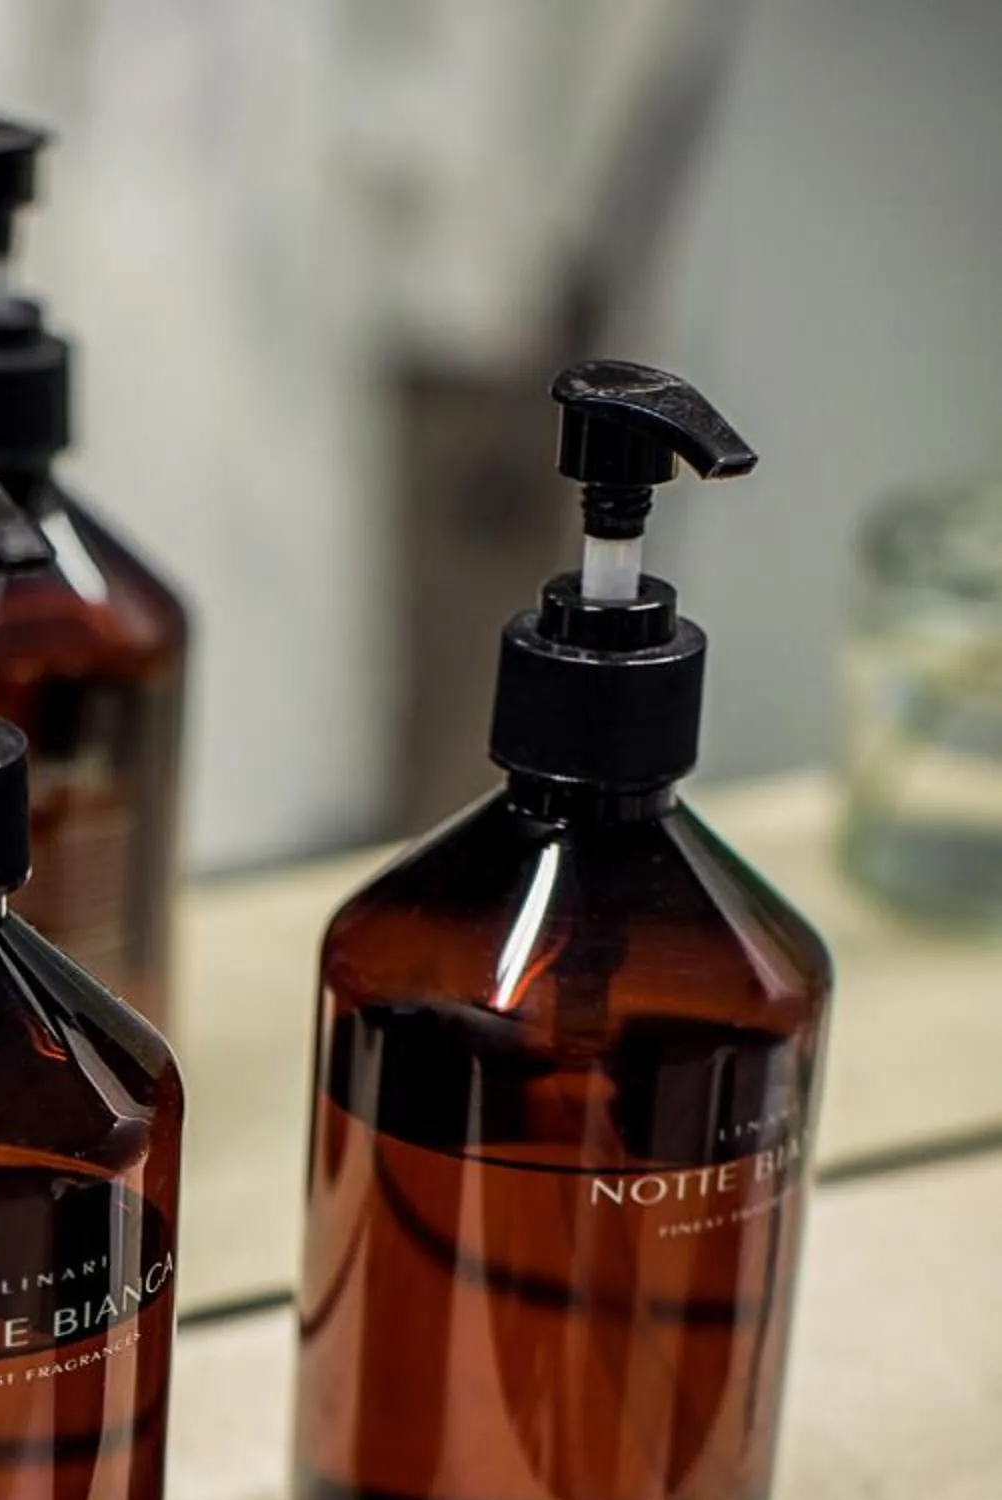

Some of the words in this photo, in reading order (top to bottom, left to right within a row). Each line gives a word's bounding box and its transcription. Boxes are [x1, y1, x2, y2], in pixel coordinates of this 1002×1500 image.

[590, 1162, 738, 1206] NOTTE
[0, 1254, 108, 1296] LINARI
[52, 1251, 174, 1338] BIANCA
